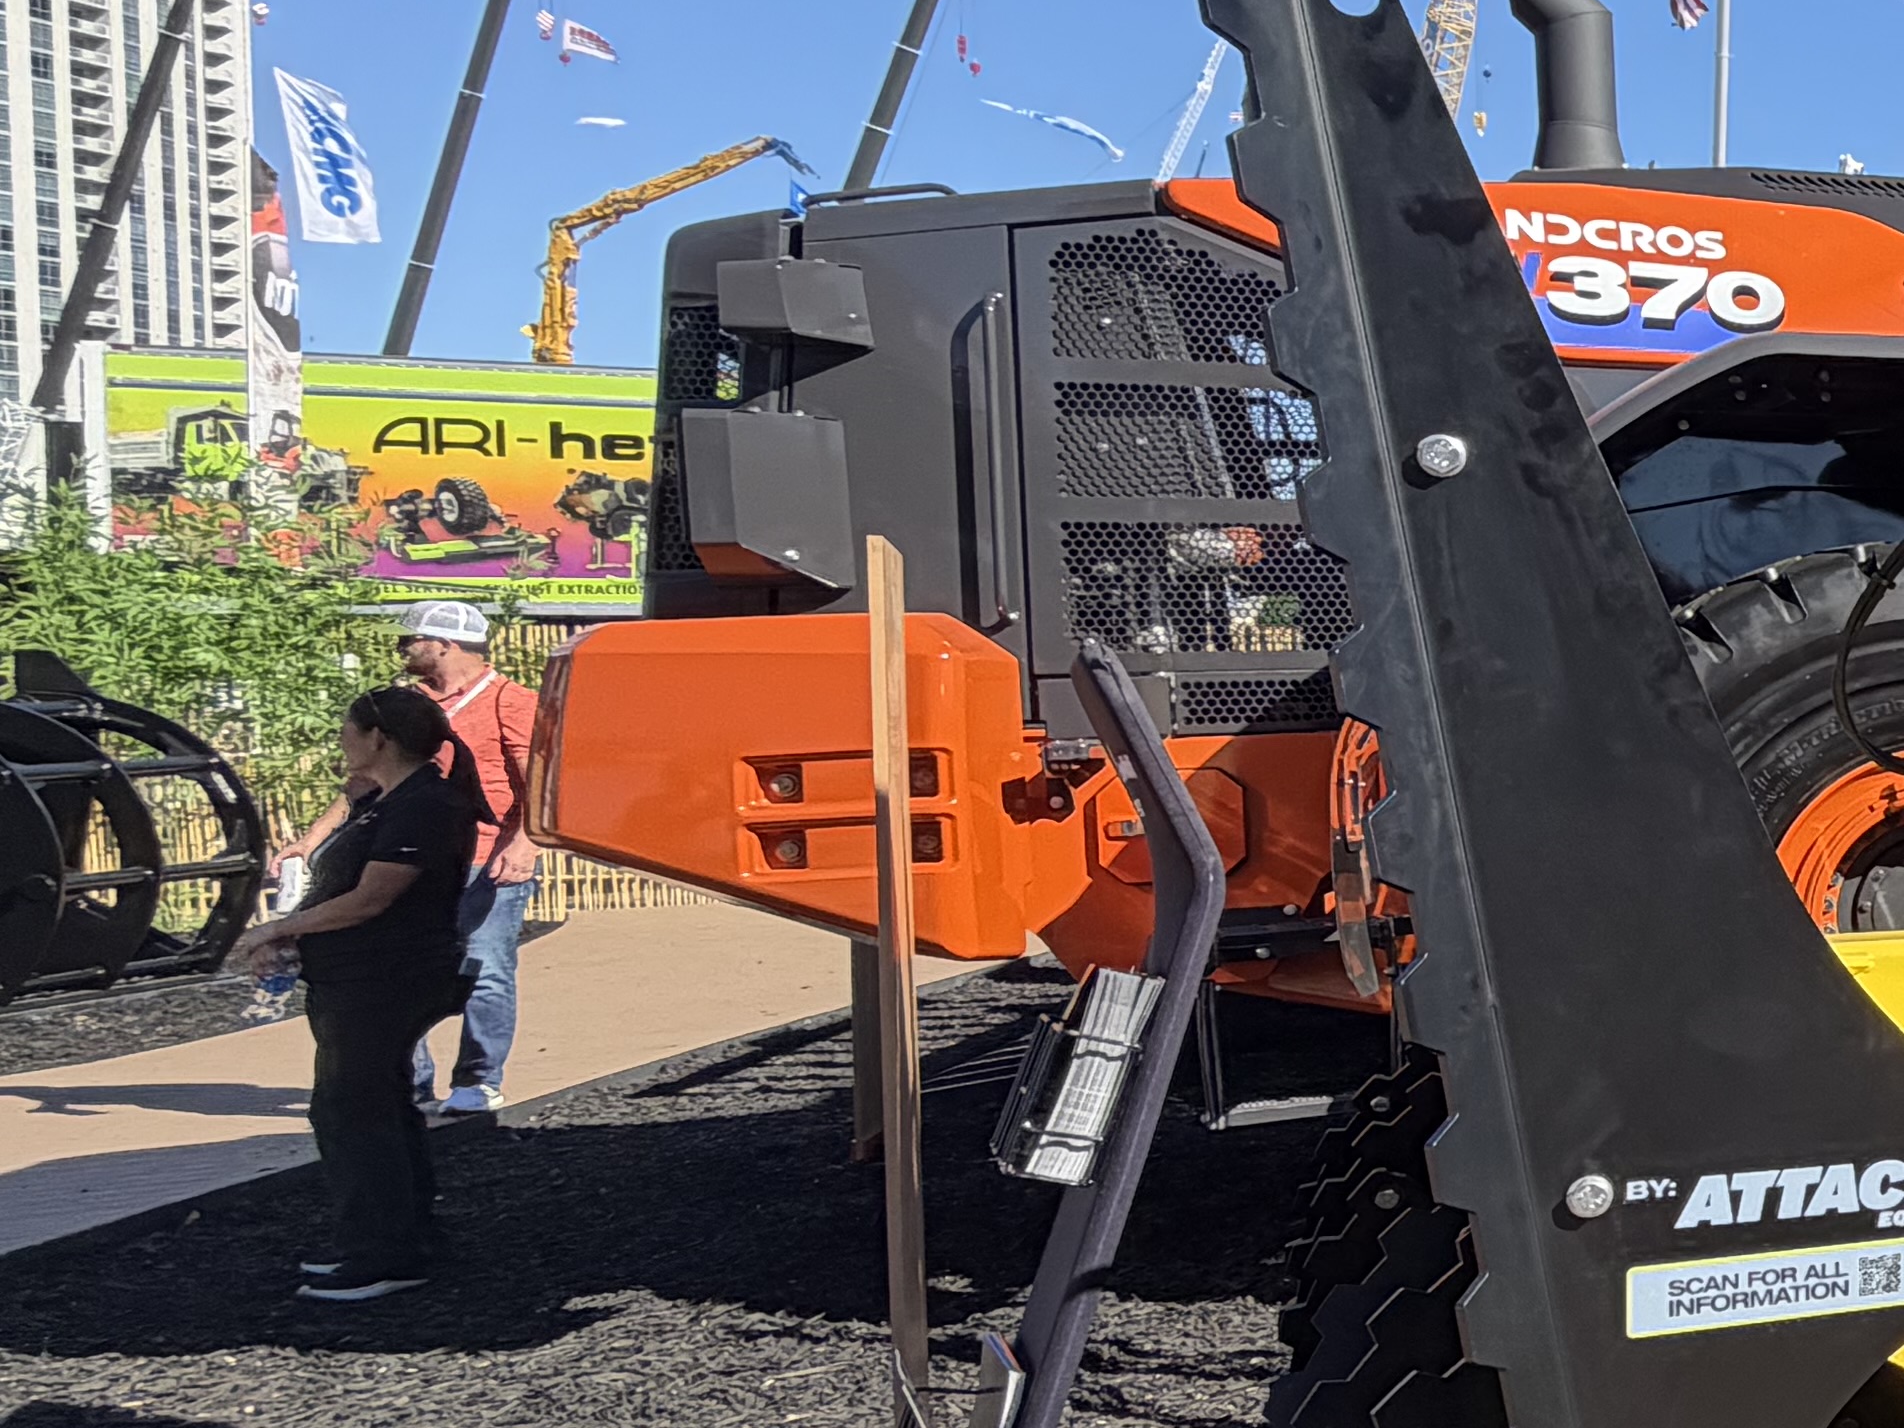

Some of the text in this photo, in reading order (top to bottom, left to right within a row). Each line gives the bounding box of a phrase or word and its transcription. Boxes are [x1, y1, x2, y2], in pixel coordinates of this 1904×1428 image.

[1504, 208, 1727, 260] NDCROS
[372, 416, 656, 461] ARI-he
[1625, 1177, 1677, 1203] BY:
[1668, 1261, 1849, 1298] SCAN FOR ALL
[1668, 1279, 1850, 1318] INFORMATION
